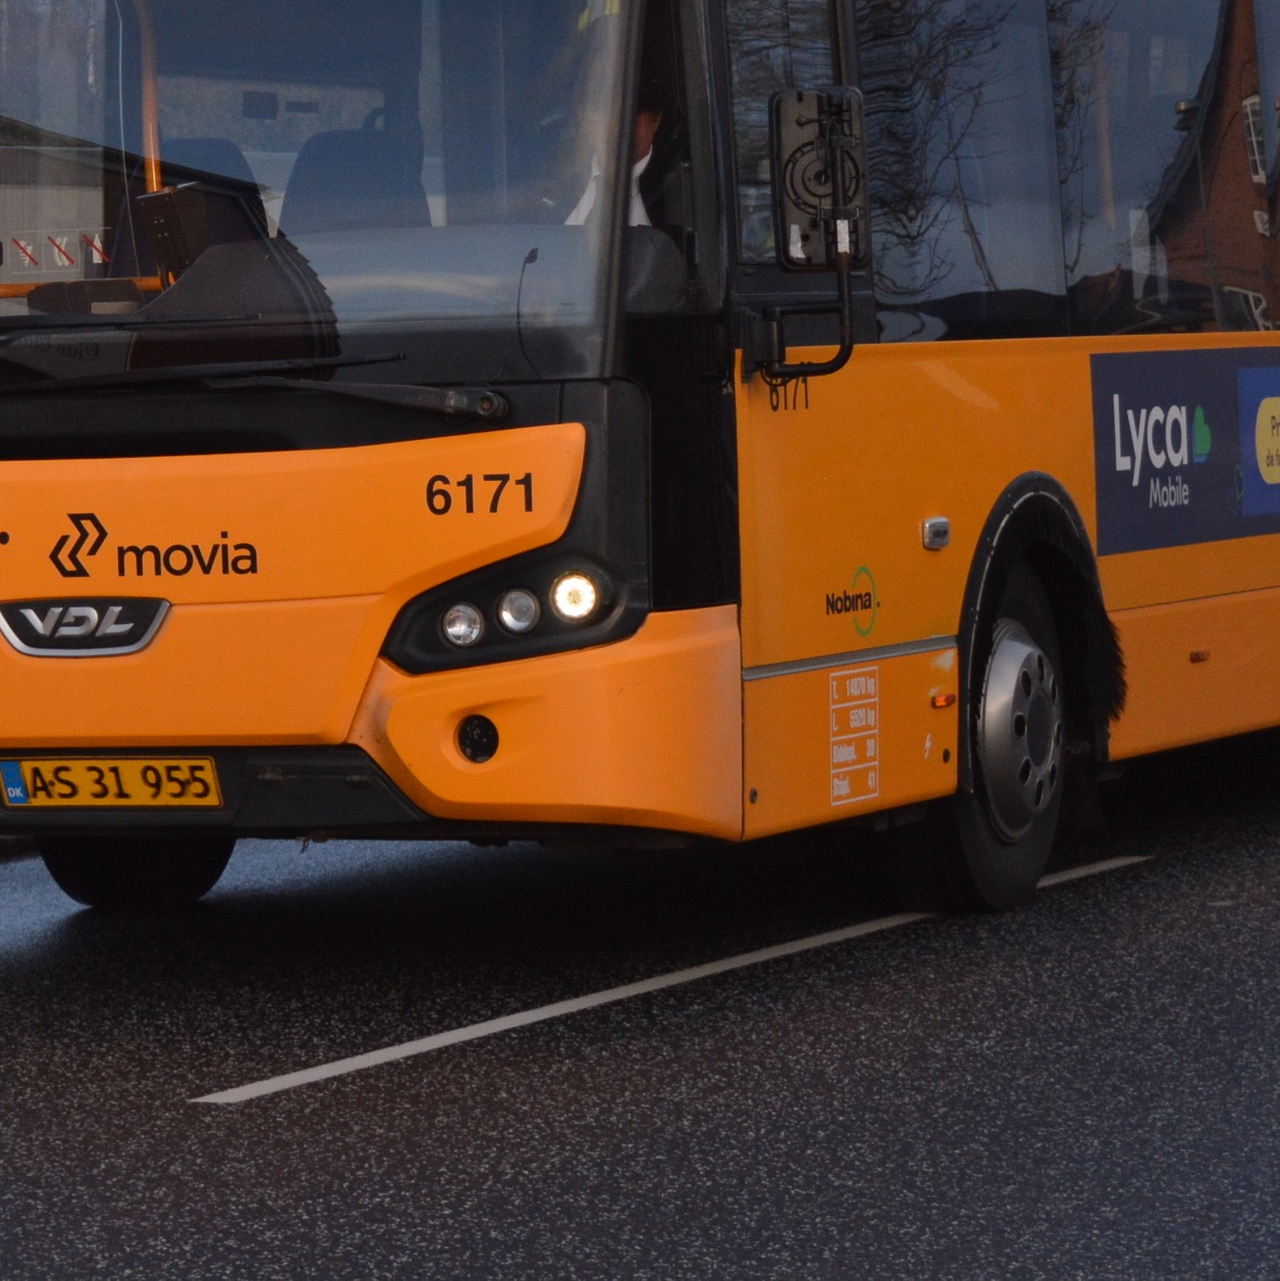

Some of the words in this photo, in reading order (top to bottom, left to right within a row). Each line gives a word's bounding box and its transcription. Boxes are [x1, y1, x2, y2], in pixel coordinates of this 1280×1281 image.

[1113, 394, 1188, 487] Lyca
[1266, 449, 1274, 467] de
[426, 473, 534, 516] 6171
[1149, 476, 1189, 509] Mobile
[117, 531, 259, 578] movia
[19, 605, 136, 638] VDL
[7, 787, 24, 798] DK
[31, 766, 78, 799] AS
[85, 766, 131, 799] 31
[141, 765, 211, 799] 955
